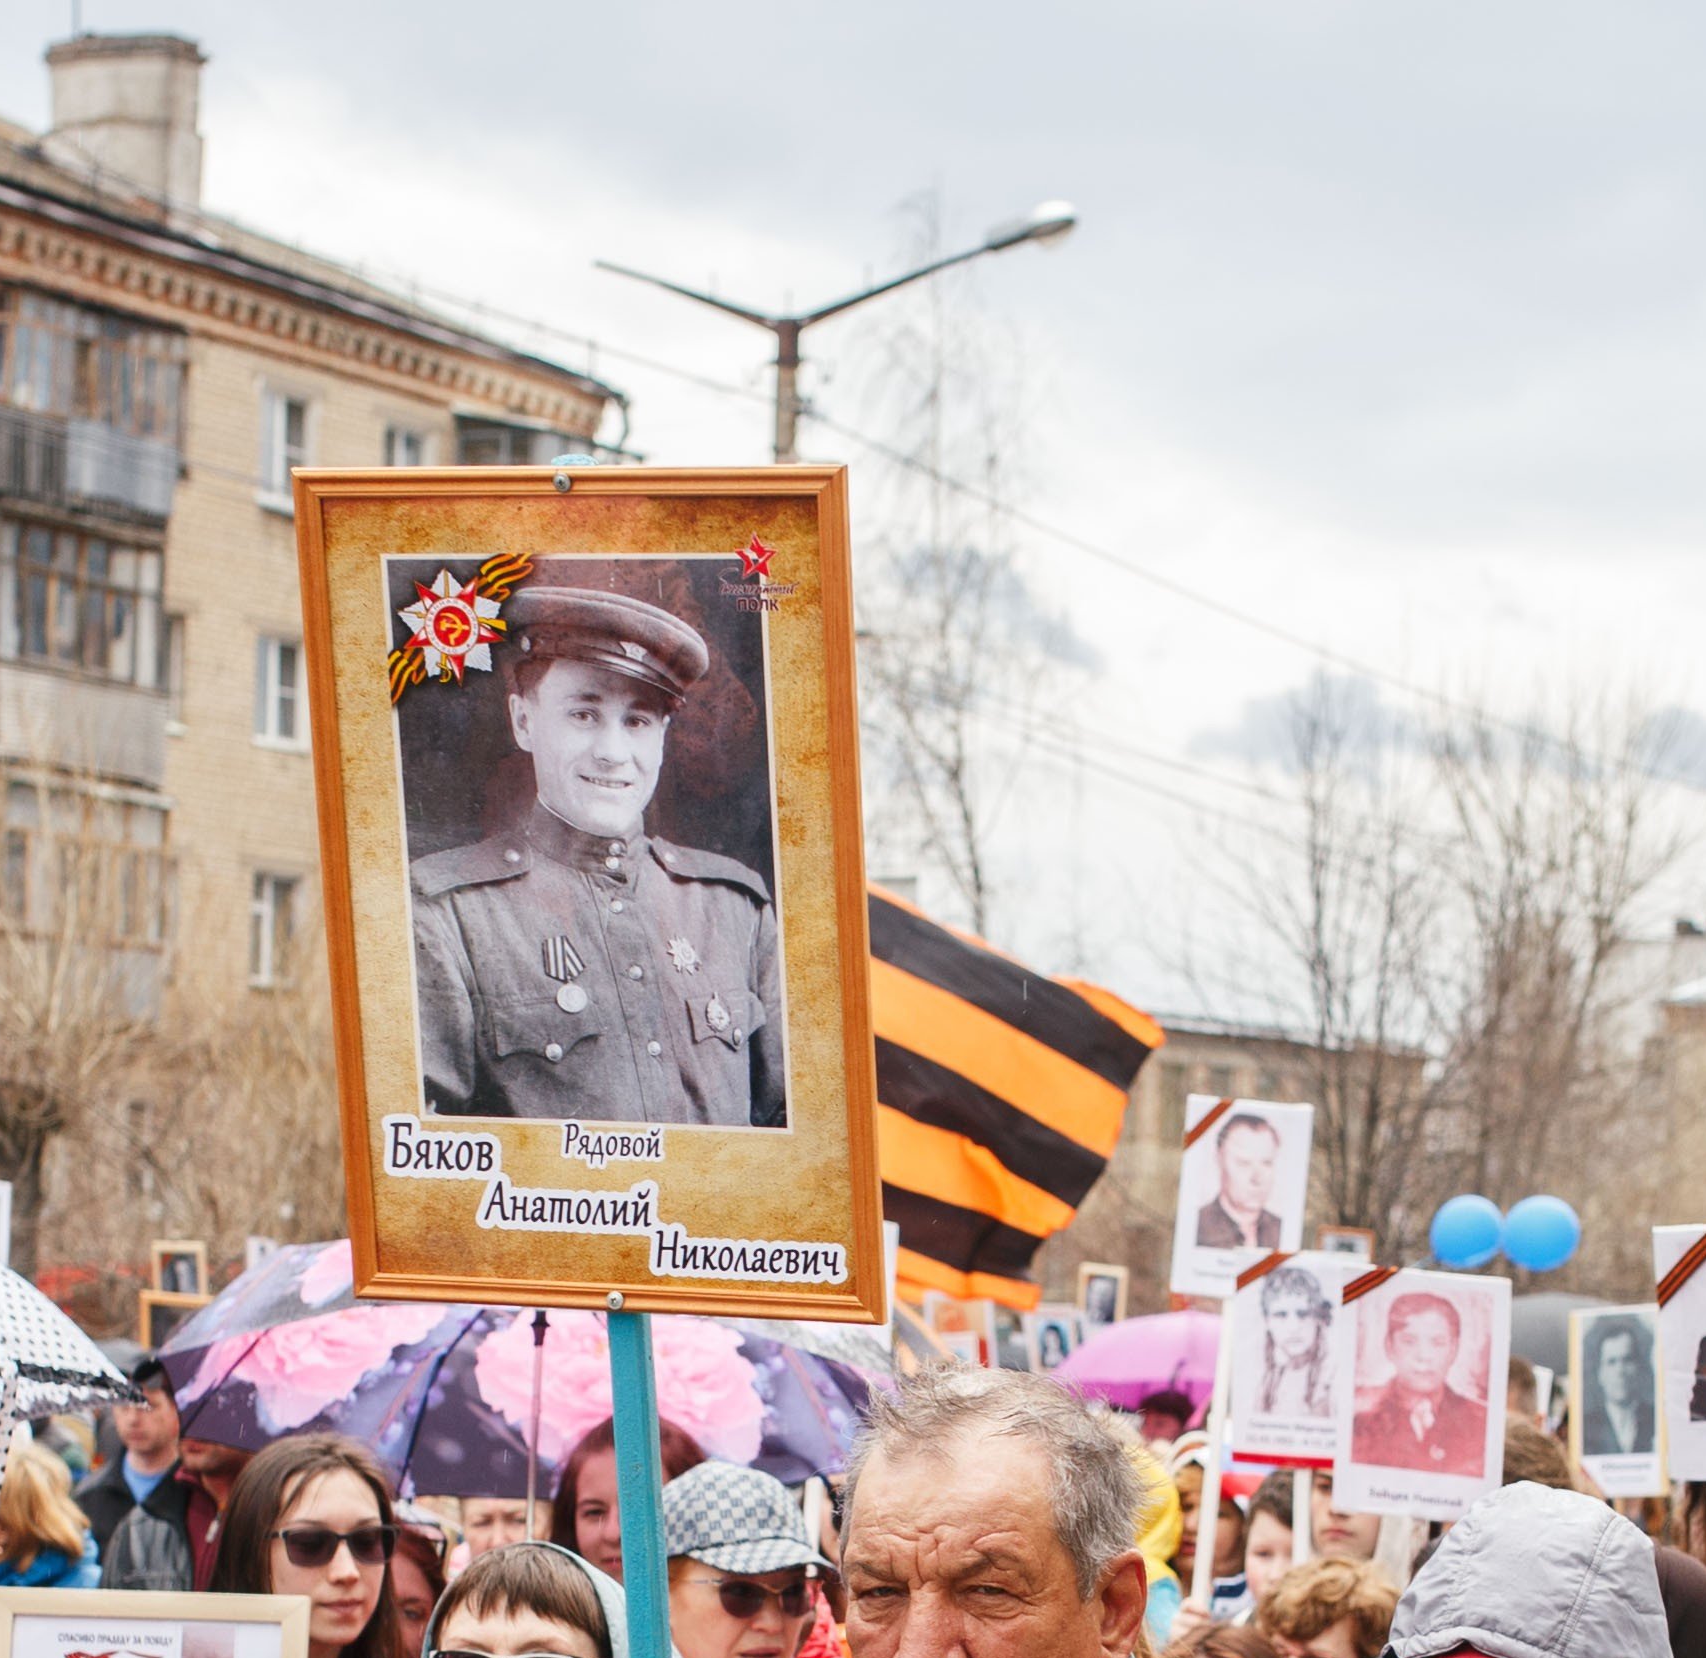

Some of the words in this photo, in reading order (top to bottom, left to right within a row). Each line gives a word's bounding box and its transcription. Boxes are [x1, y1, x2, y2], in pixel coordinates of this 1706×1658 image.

[737, 597, 779, 612] ПОЛК
[389, 1121, 495, 1172] Бяков
[563, 1122, 662, 1165] Рядовой
[484, 1180, 652, 1229] Анатолий
[656, 1230, 841, 1277] Николаевич
